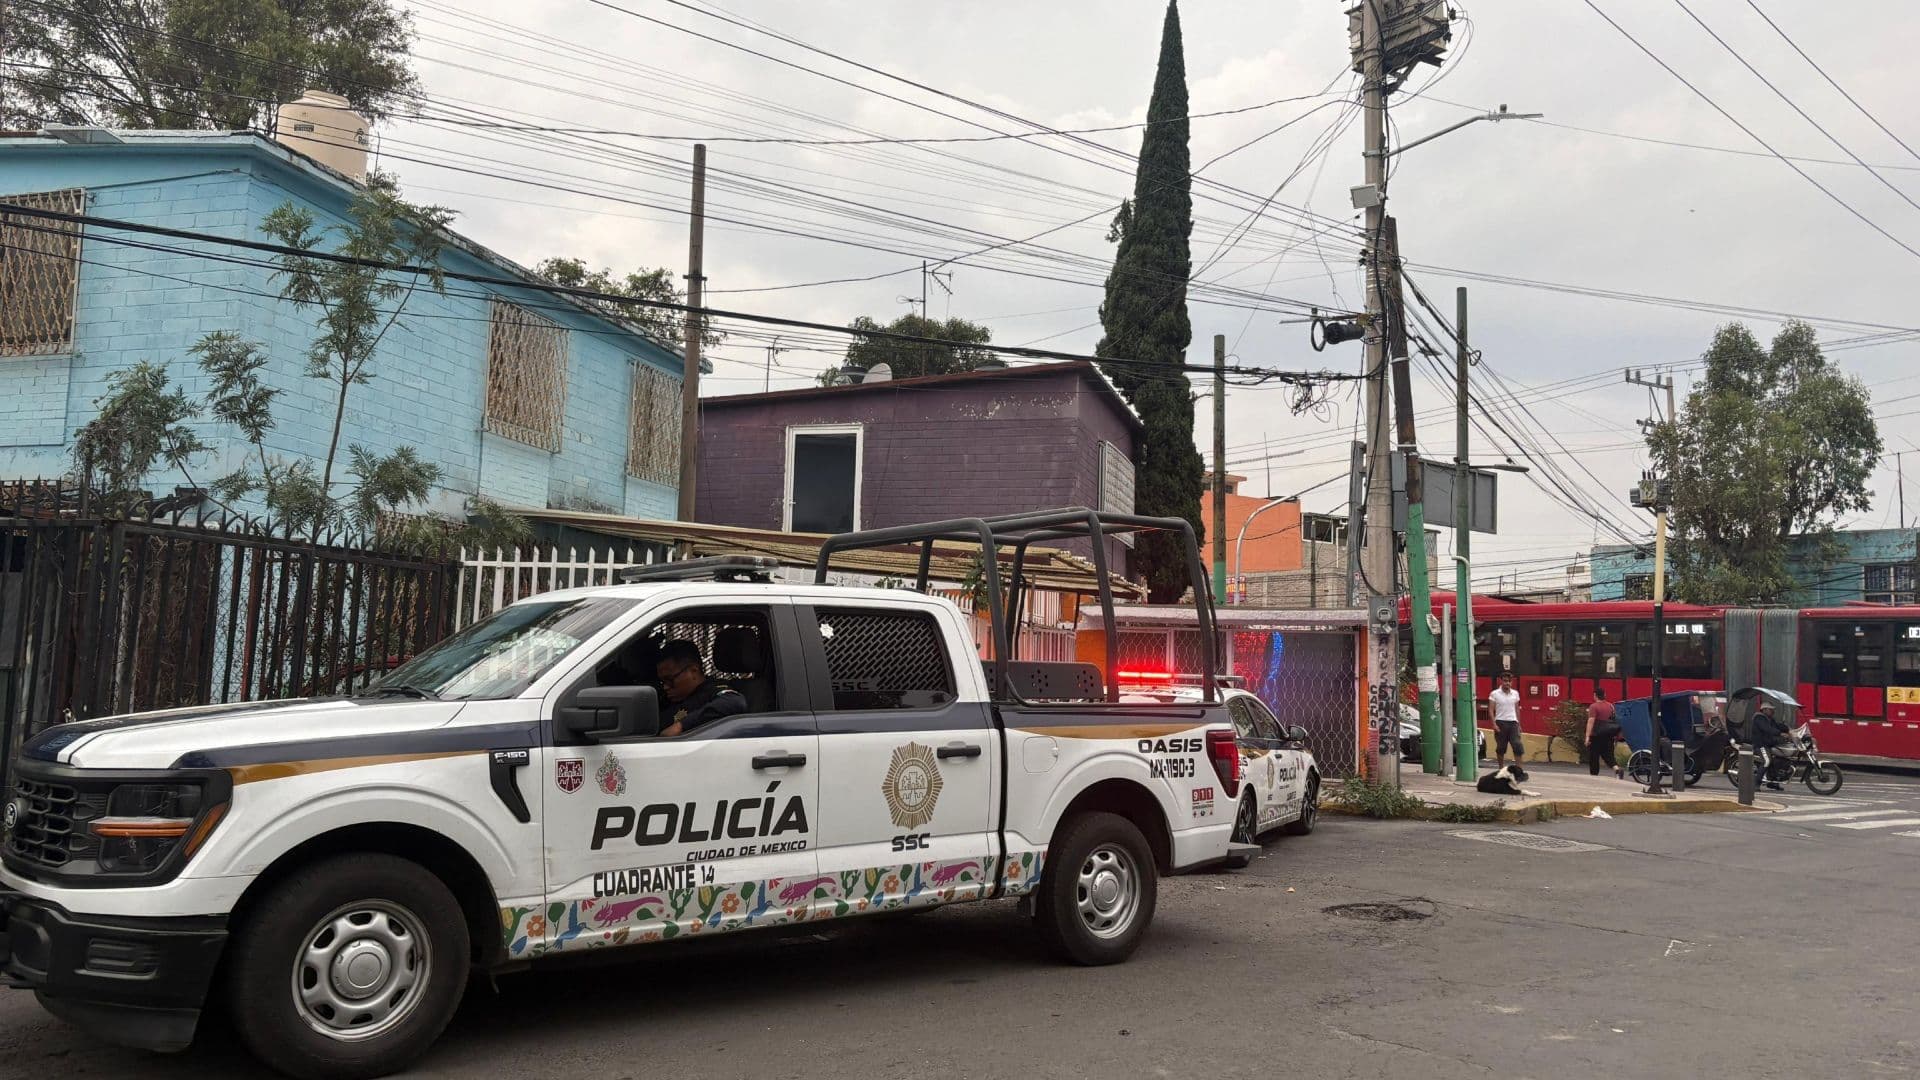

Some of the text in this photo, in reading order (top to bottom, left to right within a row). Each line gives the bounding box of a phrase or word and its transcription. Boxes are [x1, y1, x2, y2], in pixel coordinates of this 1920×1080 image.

[494, 751, 527, 759] F-150
[1138, 738, 1203, 753] OASIS
[1149, 757, 1195, 779] MX-1190-3
[1193, 788, 1212, 801] 911
[590, 780, 809, 850] POLICÍA
[686, 840, 807, 862] CIUDAD DE MEXICO
[891, 833, 931, 852] SSC
[593, 863, 716, 898] CUADRANTE 14
